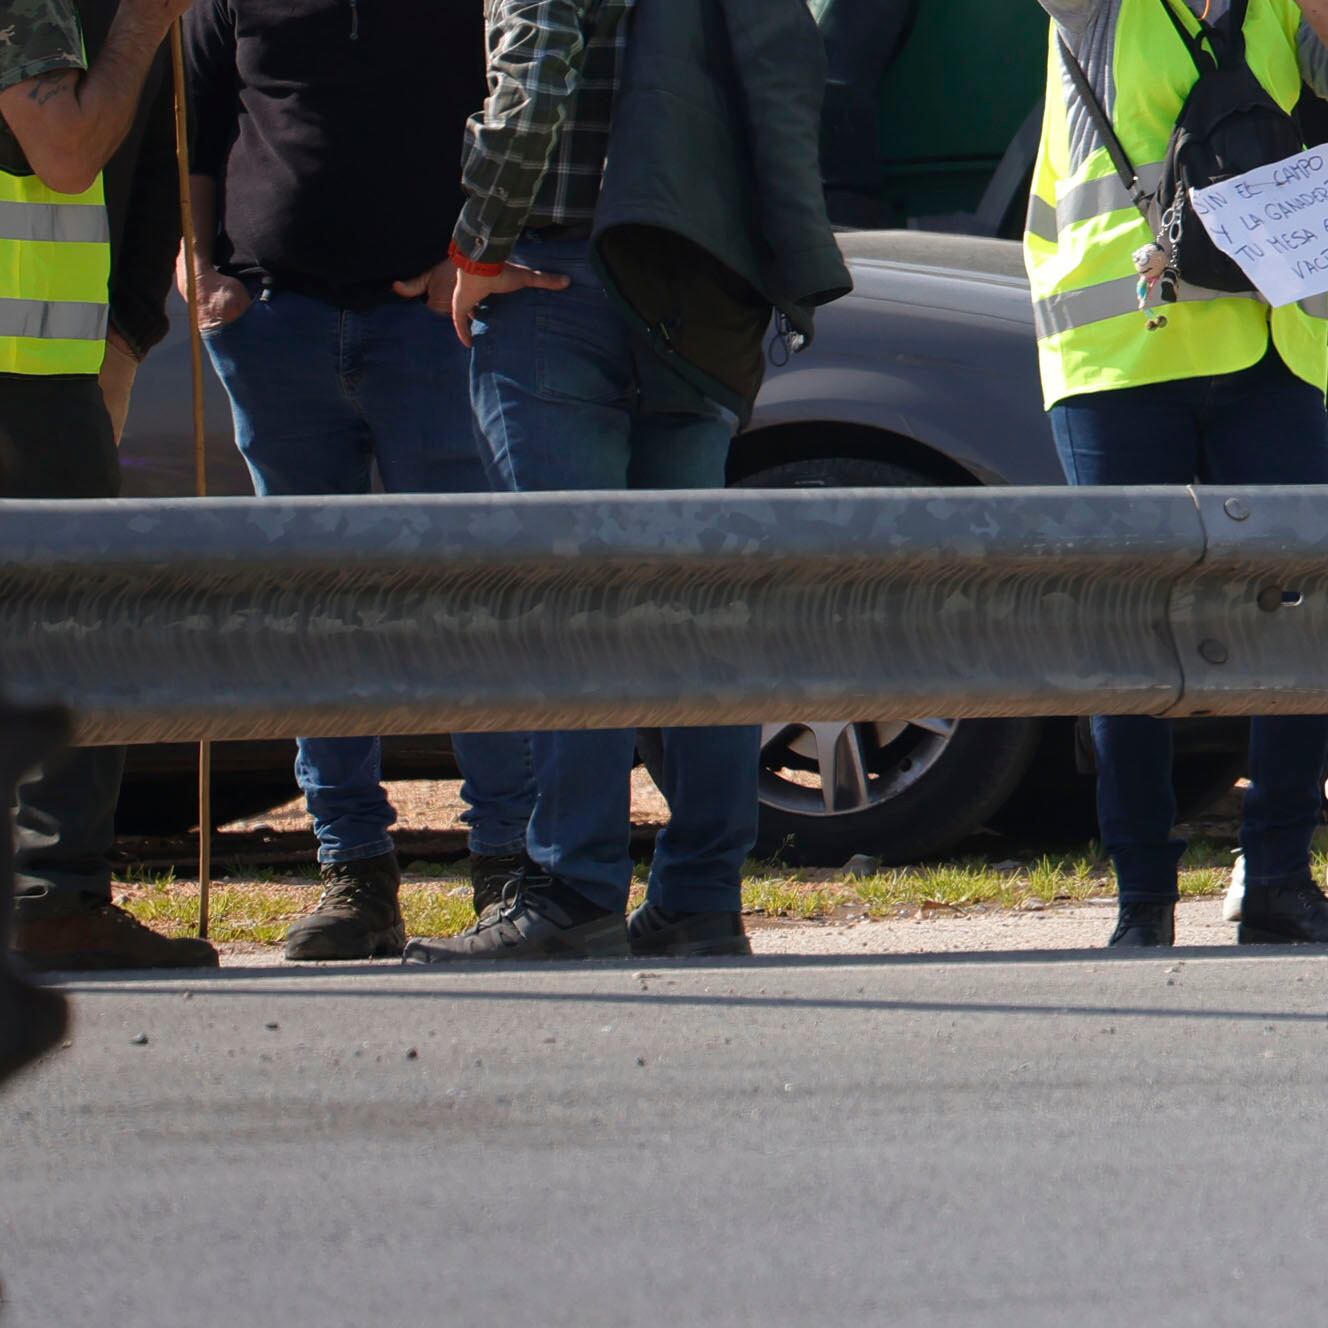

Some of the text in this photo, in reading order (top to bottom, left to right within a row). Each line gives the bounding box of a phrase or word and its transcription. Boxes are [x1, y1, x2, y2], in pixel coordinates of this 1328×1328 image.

[1194, 190, 1228, 216] SIN
[1272, 155, 1324, 187] CAMPO
[1211, 224, 1233, 244] Y
[1240, 213, 1264, 231] LA
[1235, 244, 1264, 262] TU
[1267, 228, 1318, 255] MESA
